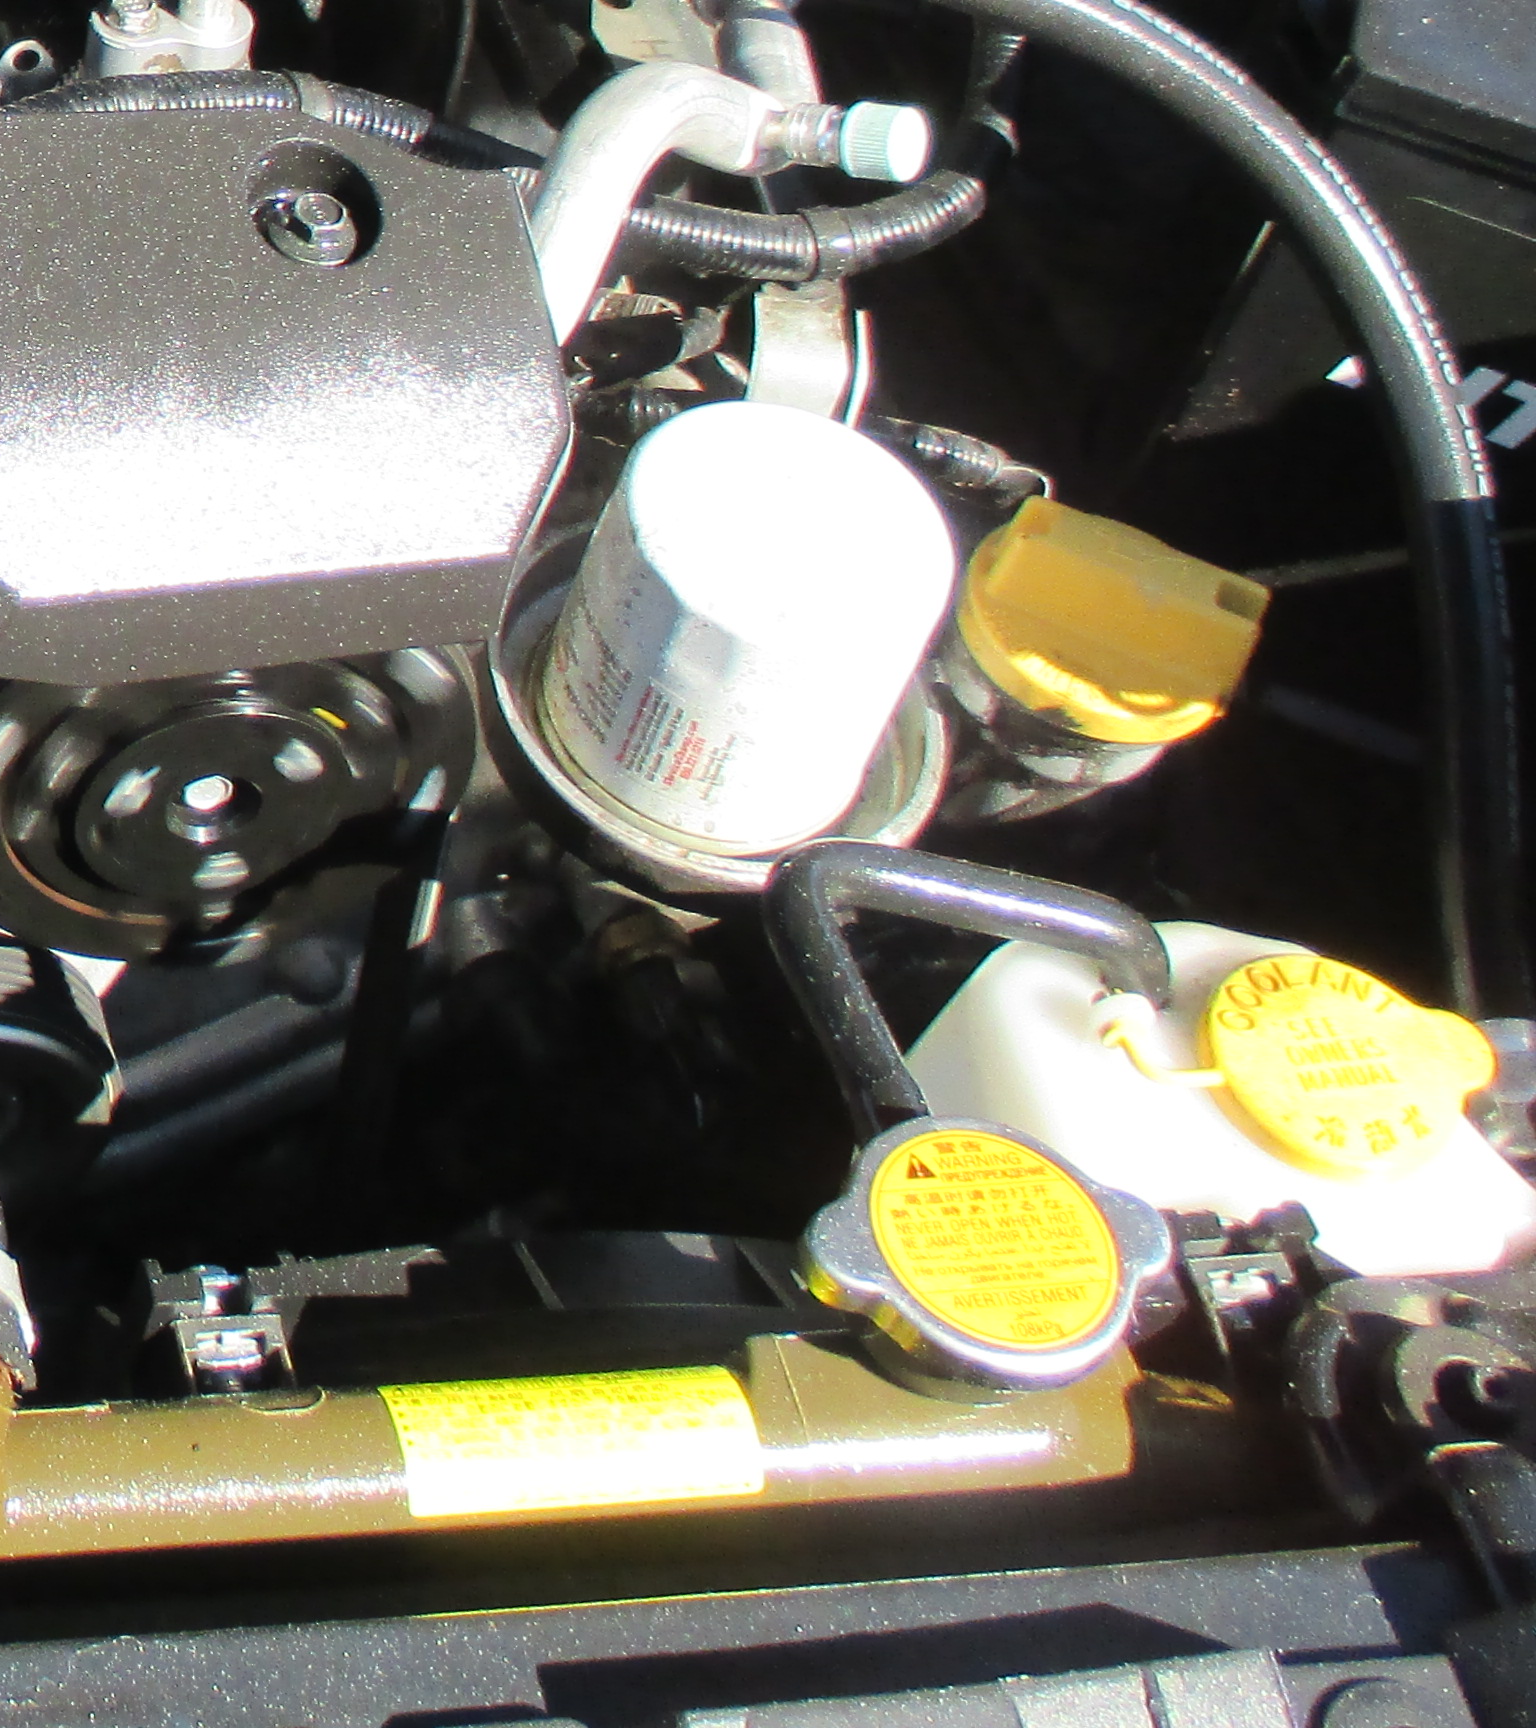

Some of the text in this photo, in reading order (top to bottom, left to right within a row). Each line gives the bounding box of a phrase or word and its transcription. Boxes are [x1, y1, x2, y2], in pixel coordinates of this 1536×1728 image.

[1216, 960, 1403, 1031] COOLANT
[1286, 1016, 1340, 1041] SEE
[1284, 1037, 1388, 1066] OWNERS
[1296, 1063, 1398, 1092] MANUAL
[934, 1151, 1022, 1170] WARNING
[894, 1220, 944, 1236] NEVER
[950, 1217, 991, 1232] OPEN
[998, 1214, 1042, 1229] WHEN
[901, 1236, 918, 1250] NE
[925, 1232, 971, 1249] JAMAIS
[975, 1229, 1022, 1246] OUVRIR
[1040, 1225, 1084, 1241] CHAUD
[953, 1285, 1089, 1309] AVERTISSEMENT
[1009, 1320, 1067, 1339] 108kPa
